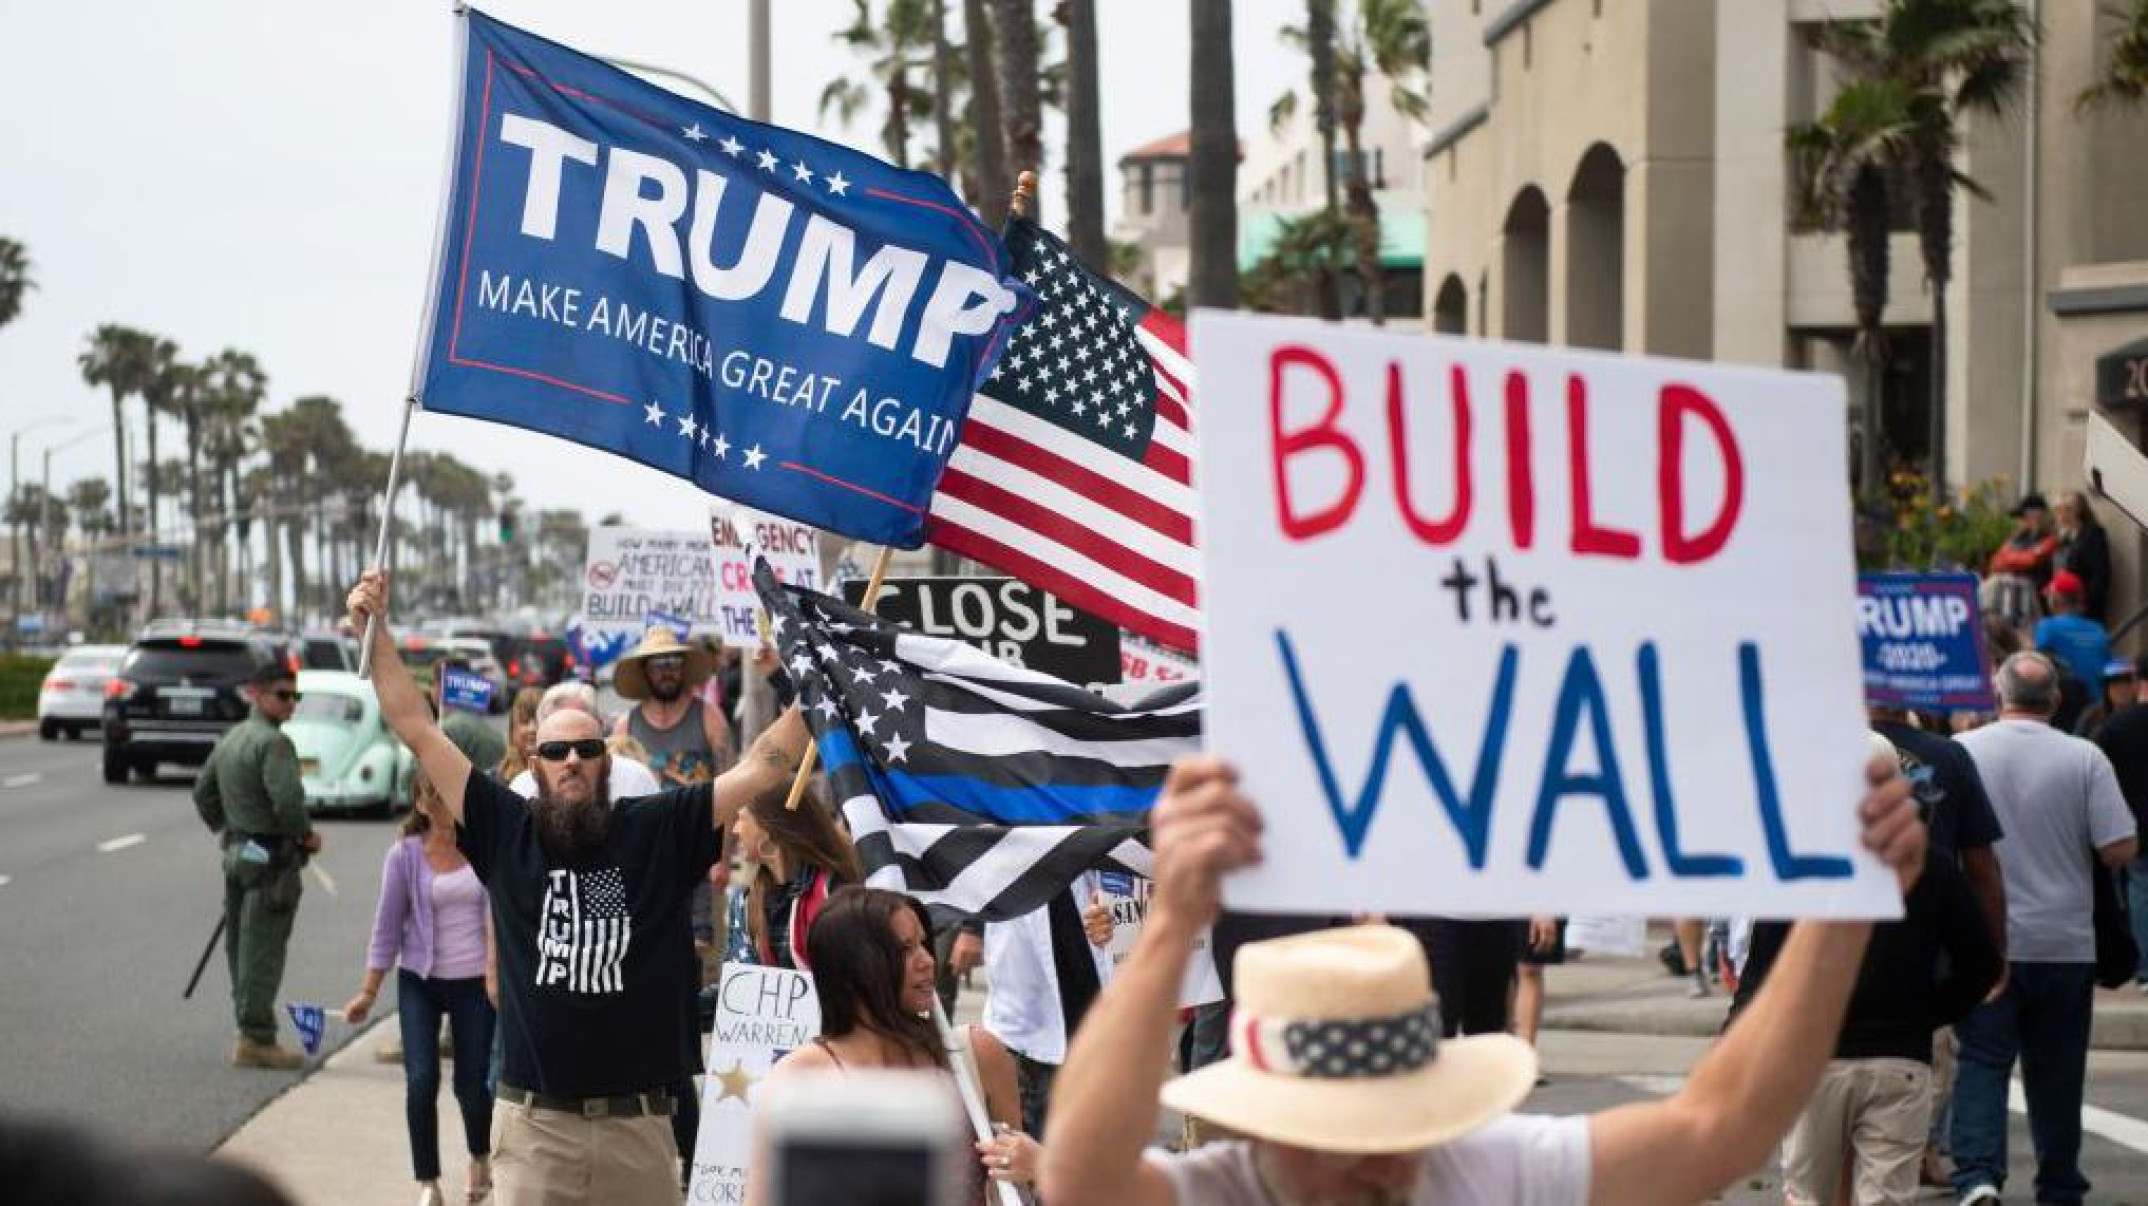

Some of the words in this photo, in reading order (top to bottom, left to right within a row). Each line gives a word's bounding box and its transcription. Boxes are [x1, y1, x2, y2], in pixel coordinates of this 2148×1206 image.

[500, 112, 1017, 369] TRUMP
[477, 269, 582, 328] MAKE
[586, 296, 713, 379] AMERICA
[721, 350, 842, 413] GREAT
[1270, 345, 1744, 565] BUILD
[588, 593, 646, 616] BUILD
[720, 605, 758, 635] THE
[1443, 556, 1557, 628] the
[1856, 594, 1969, 637] RUMP
[1275, 627, 1854, 882] WALL
[544, 869, 571, 985] TRUMP
[714, 1019, 808, 1045] WARREN
